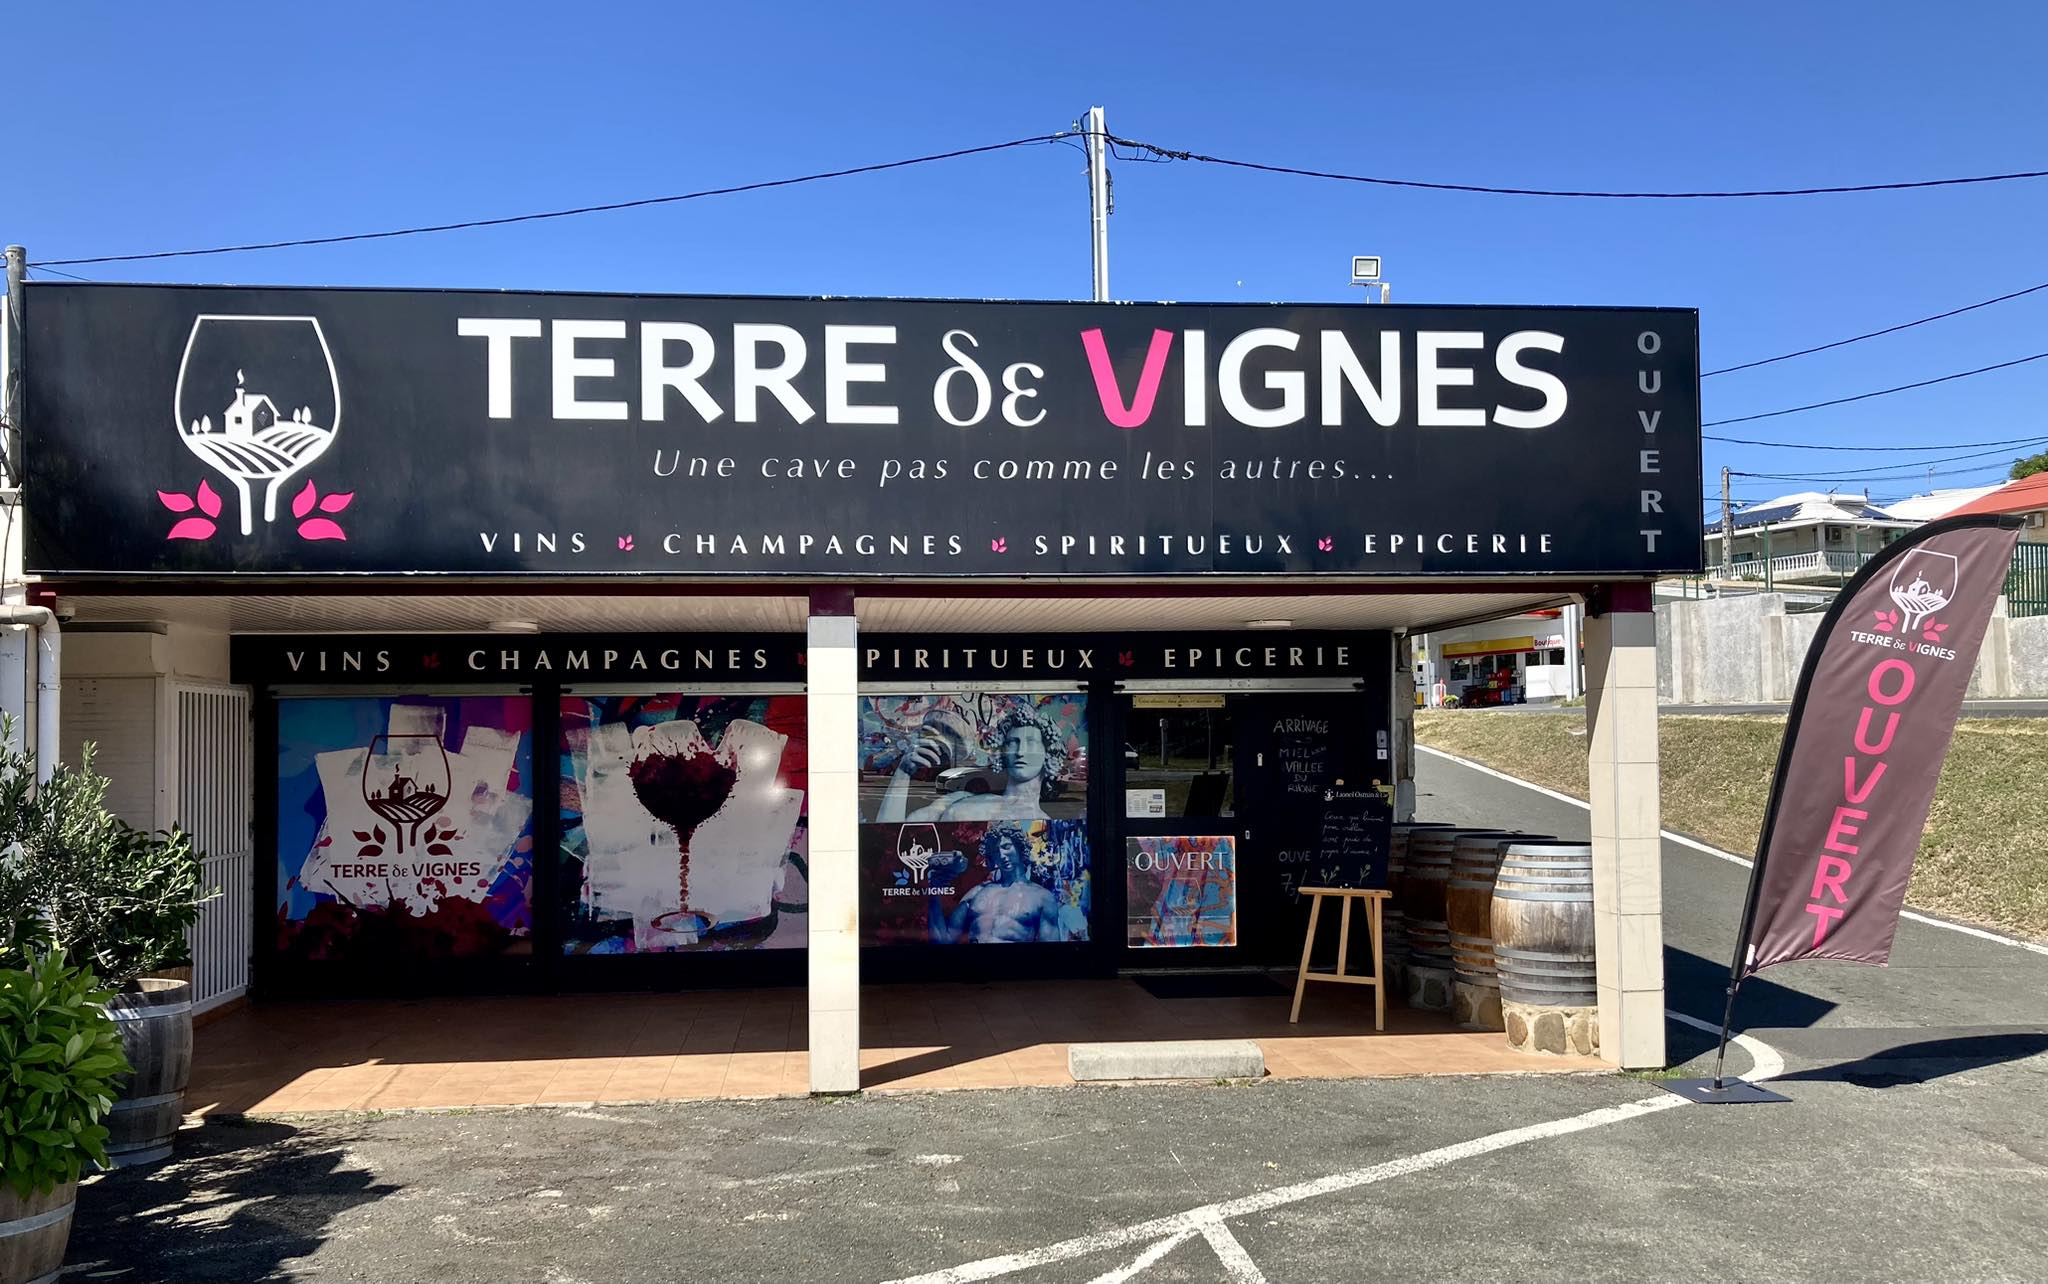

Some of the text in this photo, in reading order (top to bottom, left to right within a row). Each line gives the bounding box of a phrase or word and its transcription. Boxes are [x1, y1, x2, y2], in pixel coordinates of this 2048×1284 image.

[457, 317, 899, 426] TERRE
[1081, 328, 1568, 429] VIGNES
[1636, 330, 1665, 555] OUVERT
[653, 449, 1395, 487] Une cave pas comme les autres...
[480, 532, 1553, 556] VINS CHAMPAGNES SPIRITUEUX EPICERIE
[1851, 630, 1892, 649] TERRE
[1908, 641, 1956, 661] VIGNES
[286, 646, 1350, 673] VINS CHAMPAGNES PIRITUEUX EPICERIE
[1272, 714, 1329, 734] ARRIVAGE
[1805, 658, 1916, 950] OUVERT
[1134, 851, 1229, 872] OUVERT
[1278, 849, 1312, 863] OUVE
[331, 863, 389, 879] TERRE
[412, 862, 481, 878] VIGNES
[882, 886, 911, 897] TERRE
[921, 886, 956, 897] VIGNES
